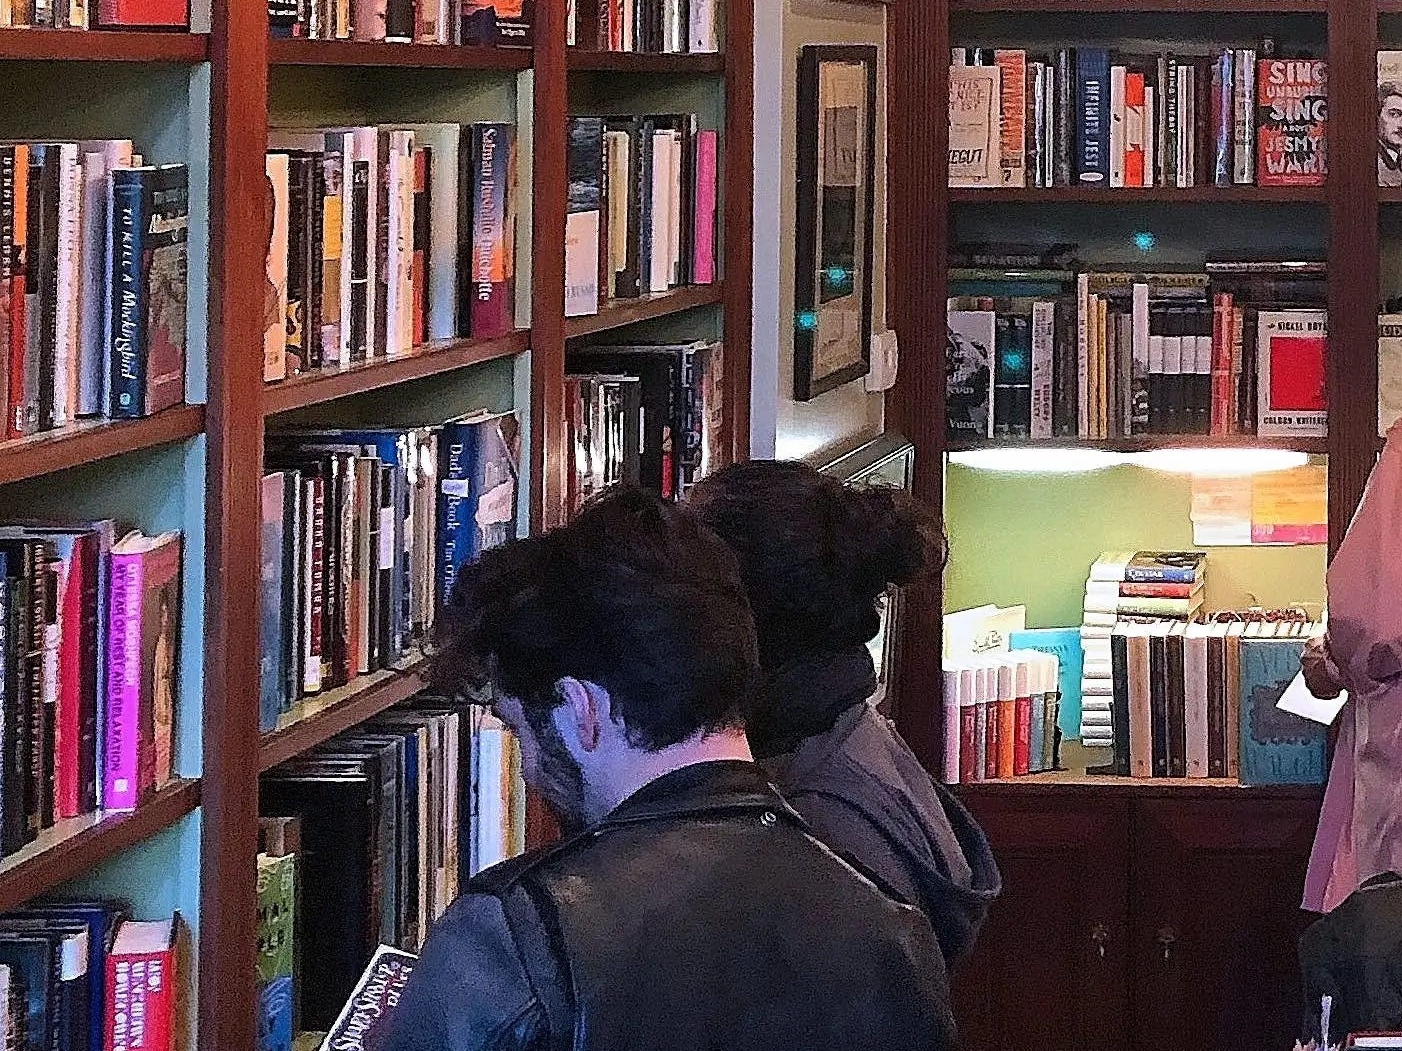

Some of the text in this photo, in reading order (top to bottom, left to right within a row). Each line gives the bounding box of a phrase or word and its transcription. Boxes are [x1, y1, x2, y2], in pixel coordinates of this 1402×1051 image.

[1085, 80, 1100, 167] INFINITE JEST
[481, 127, 496, 179] Salman
[121, 230, 134, 268] KILL
[121, 273, 133, 283] A
[114, 289, 138, 380] Mockingbird
[446, 495, 462, 530] Book
[108, 697, 122, 772] RELAXATION
